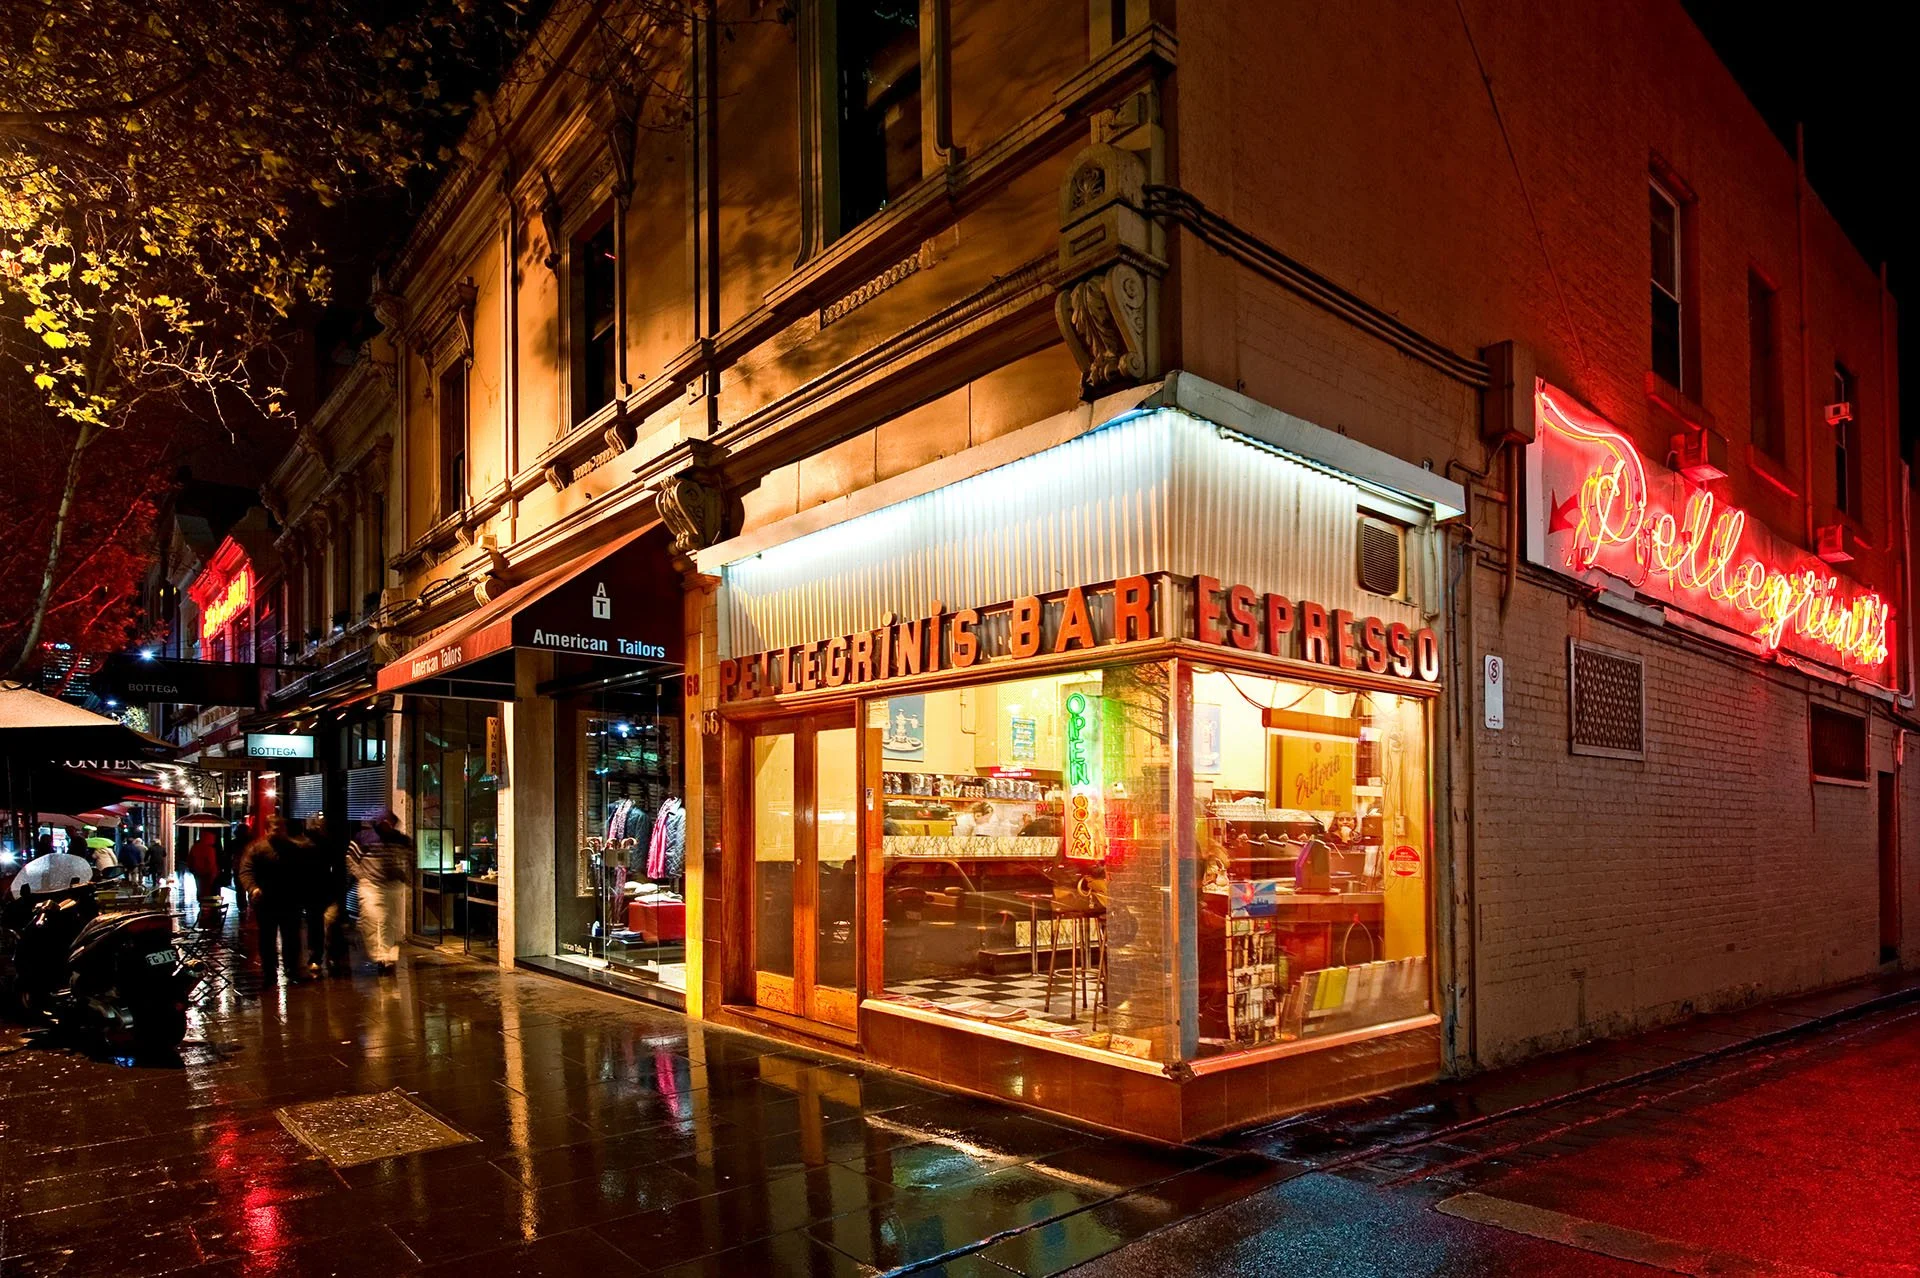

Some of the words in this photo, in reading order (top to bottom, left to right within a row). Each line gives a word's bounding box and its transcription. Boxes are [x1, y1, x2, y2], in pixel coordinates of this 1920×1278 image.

[1011, 575, 1150, 659] BAR
[1194, 575, 1439, 682] ESPRESSO
[533, 629, 608, 651] American
[617, 638, 666, 658] Tailors
[412, 655, 439, 679] American
[440, 646, 462, 668] Tailors
[128, 683, 178, 694] BOTTEGA
[687, 673, 700, 697] 68
[490, 719, 498, 749] WINE
[703, 710, 719, 736] 66
[251, 746, 297, 757] BOTTEGA
[1066, 692, 1090, 786] OPEN
